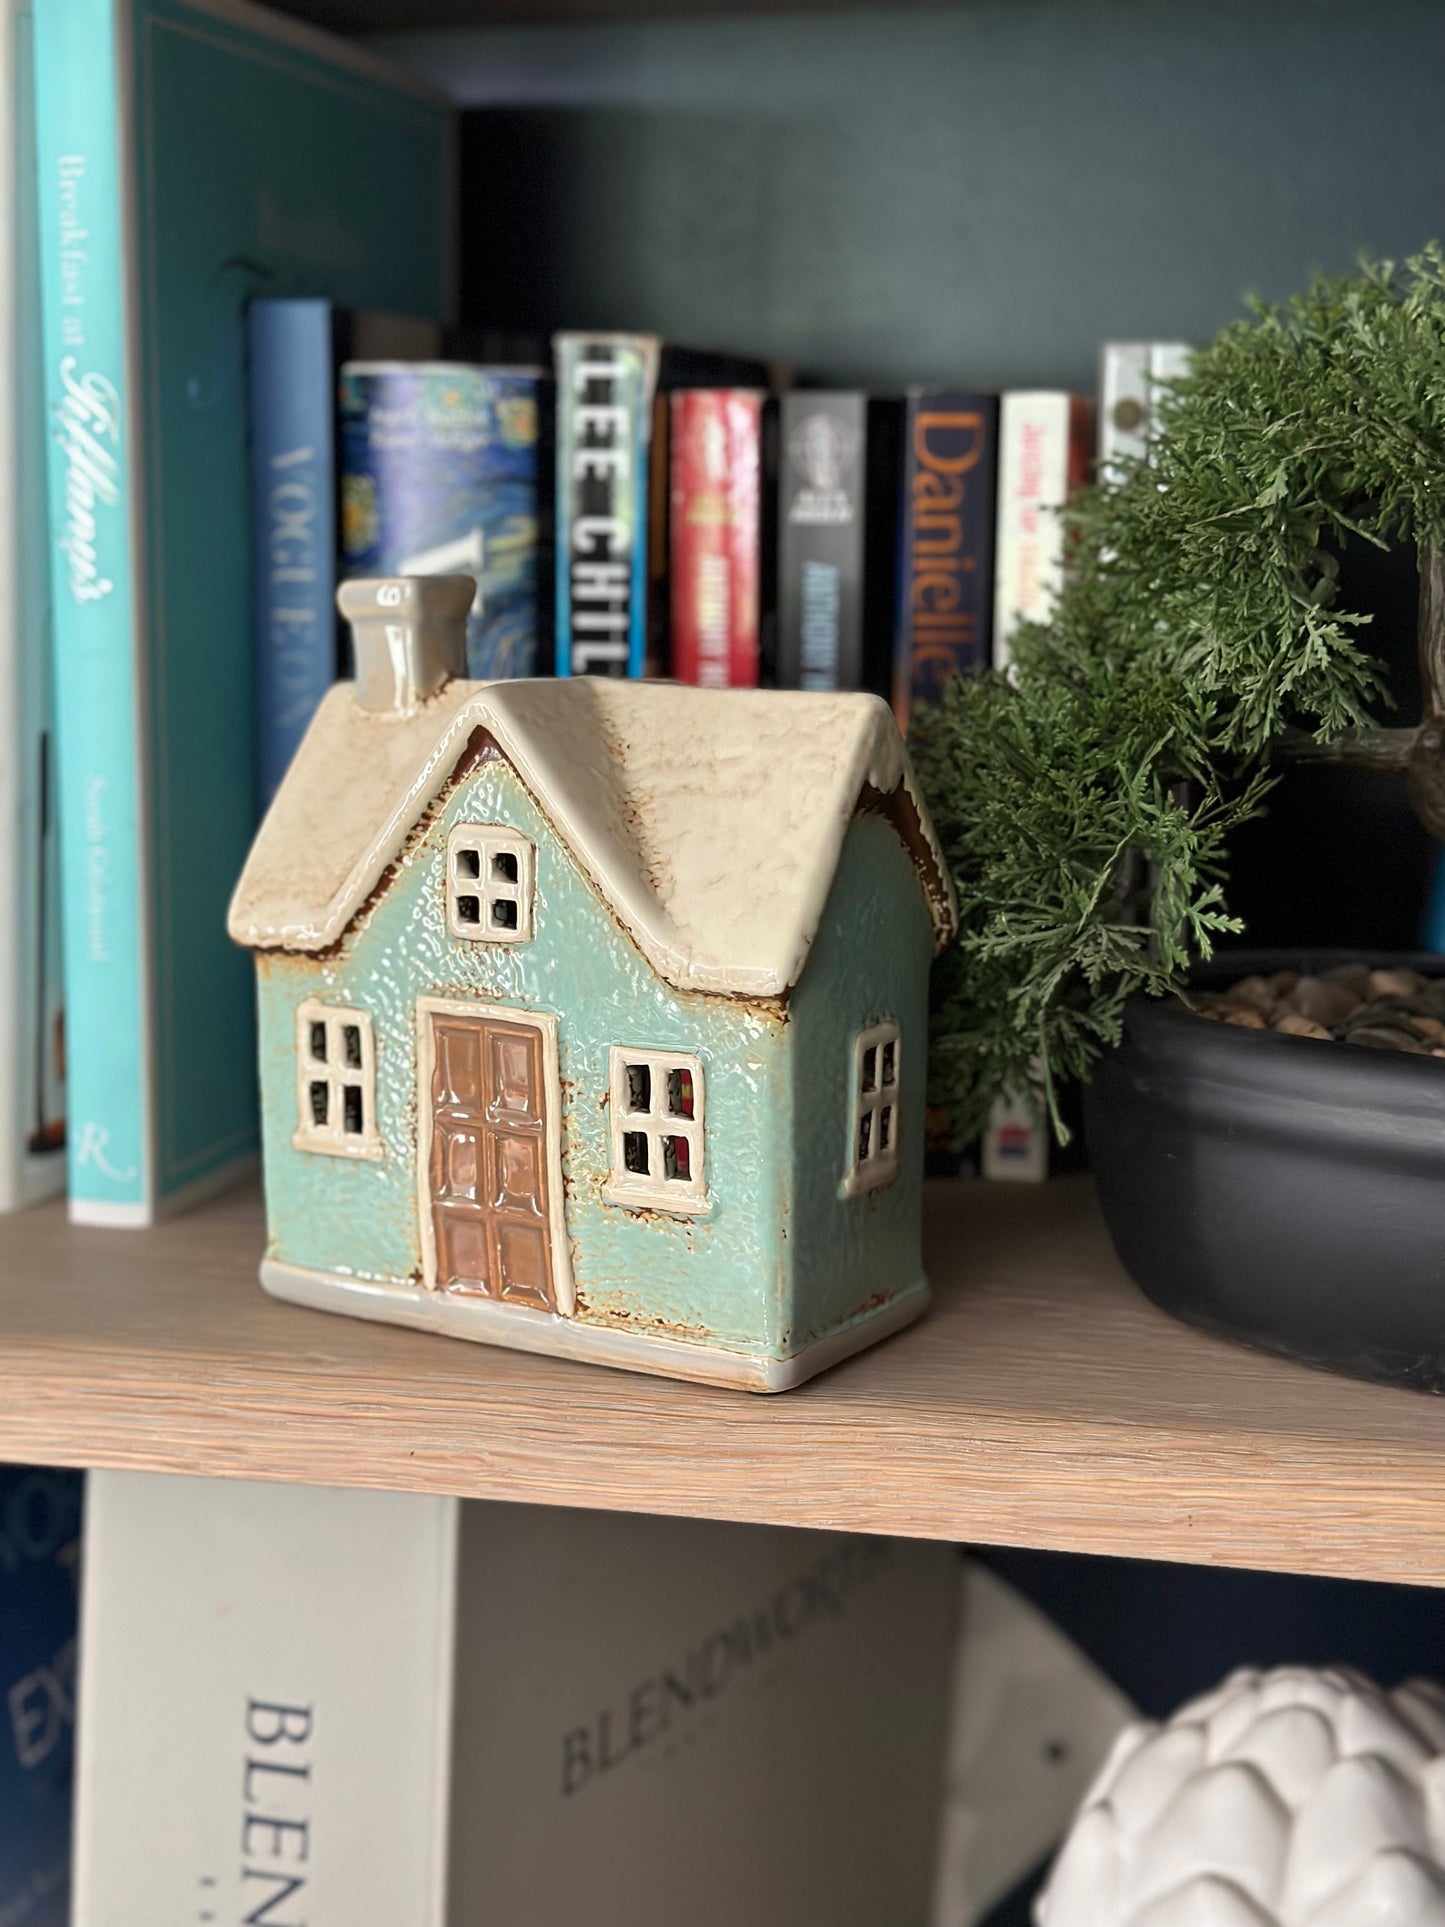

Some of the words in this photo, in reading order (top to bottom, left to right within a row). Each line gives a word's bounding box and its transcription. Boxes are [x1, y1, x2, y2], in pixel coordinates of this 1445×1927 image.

[58, 155, 90, 307] Breakfast
[61, 316, 84, 346] at
[53, 356, 121, 605] Tiffany's
[573, 360, 630, 480] LEE
[270, 445, 317, 646] VOGUE
[911, 410, 984, 684] Danielle
